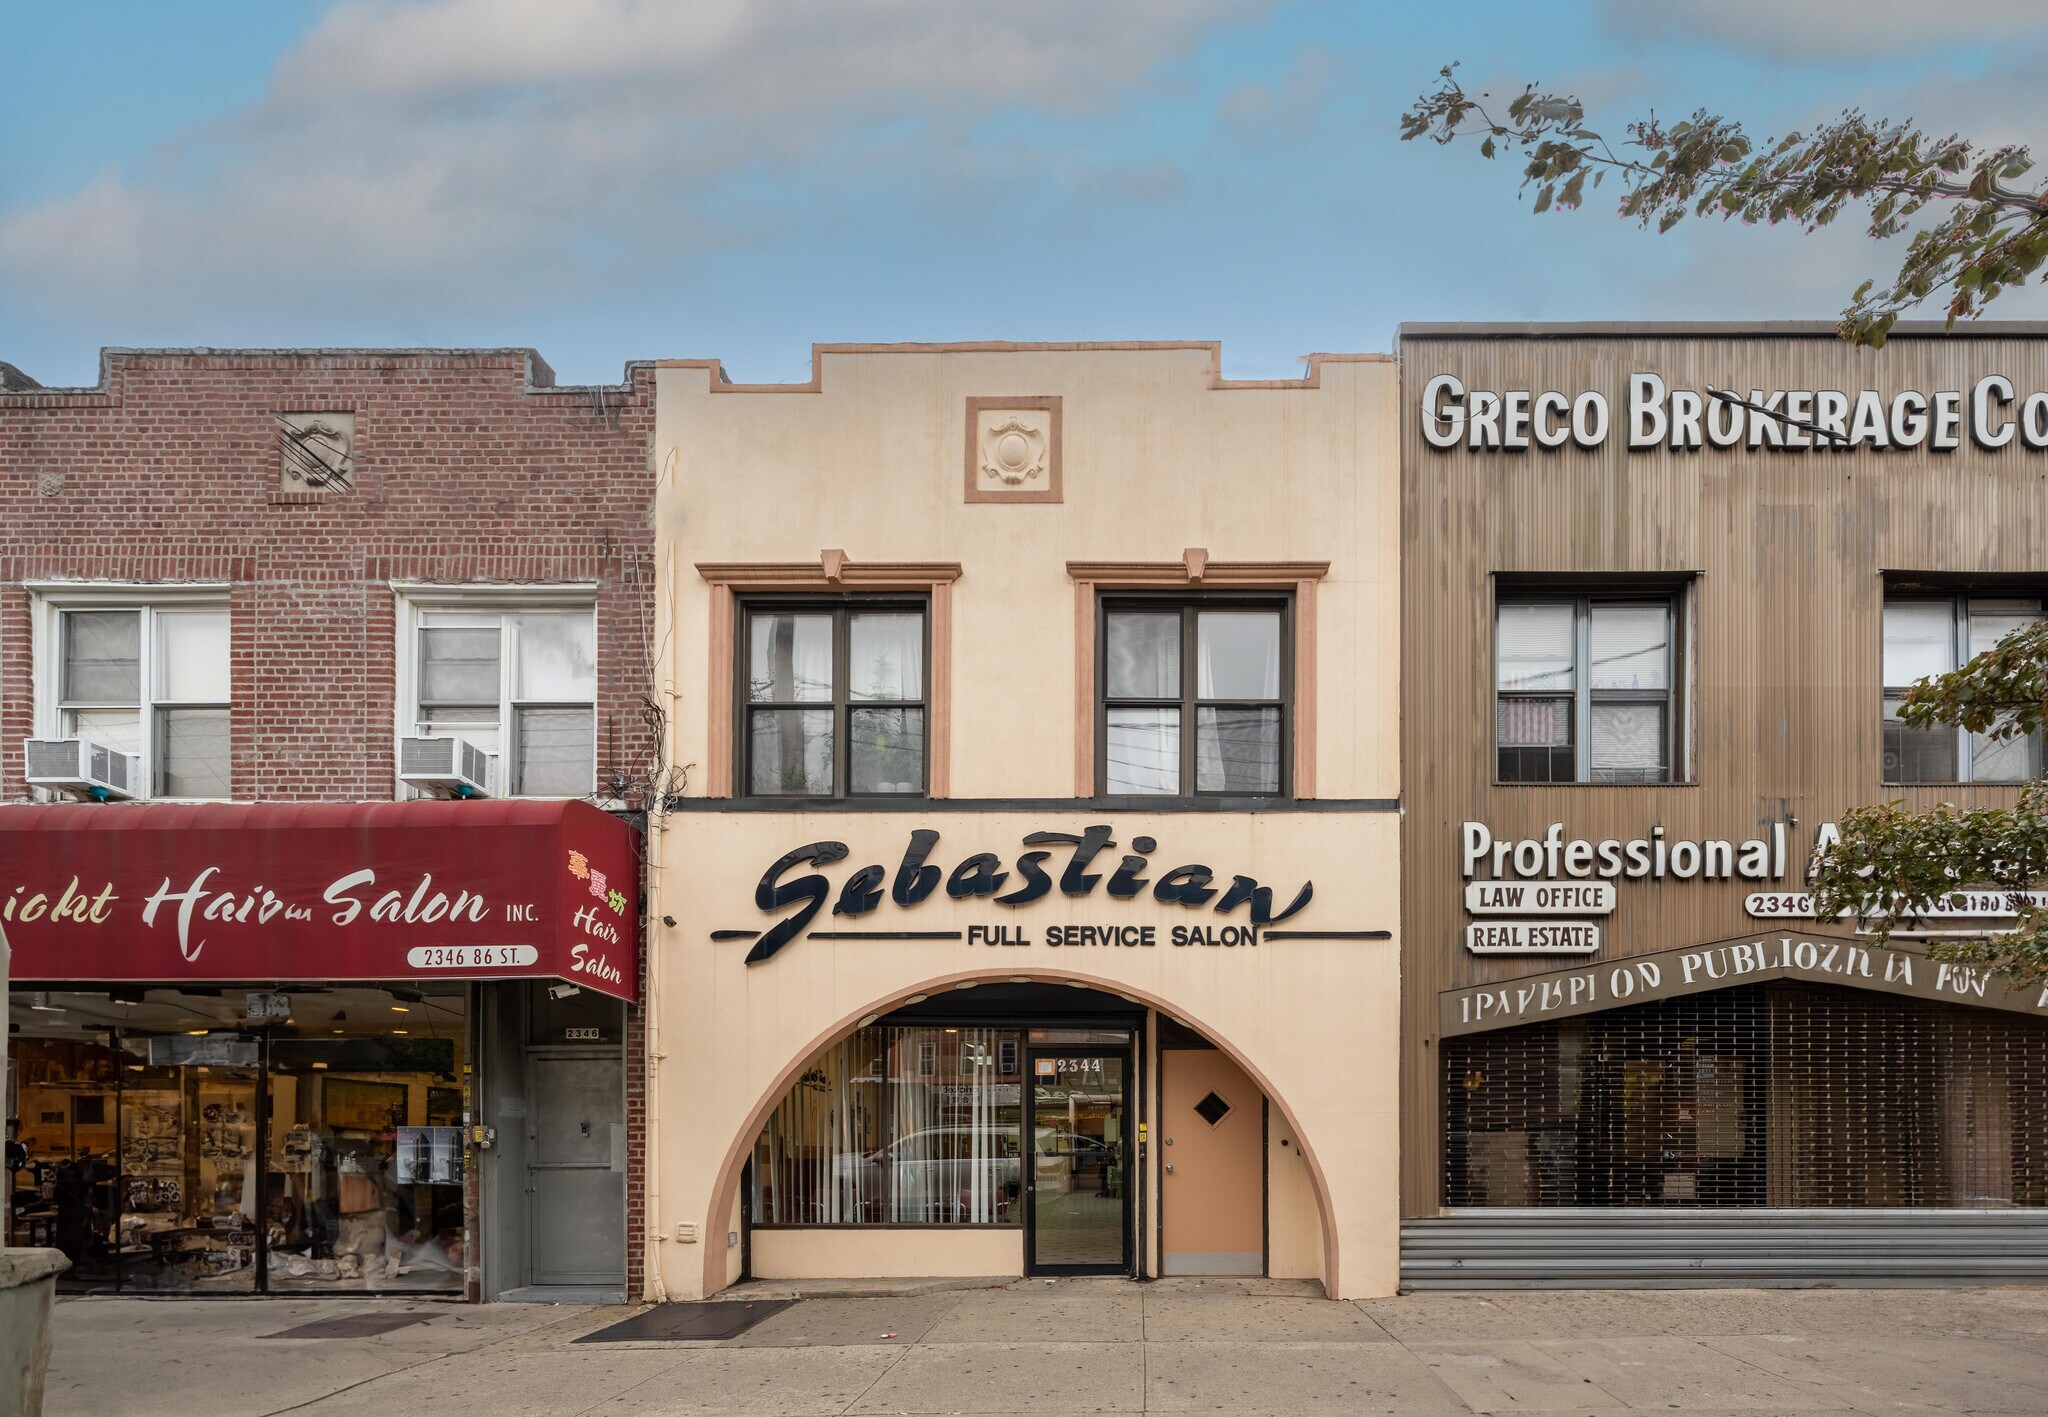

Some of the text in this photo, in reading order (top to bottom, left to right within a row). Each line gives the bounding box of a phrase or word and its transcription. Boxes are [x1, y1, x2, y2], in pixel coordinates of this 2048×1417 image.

[1422, 373, 1609, 449] GRECO
[1461, 821, 1786, 879] Professional
[323, 868, 490, 926] Salon
[506, 904, 539, 922] INC.
[744, 825, 1314, 965] Sebastian
[1479, 887, 1603, 908] LAW OFFICE
[573, 905, 620, 944] Hair
[967, 925, 1258, 947] FULL SERVICE SALON
[1473, 927, 1594, 947] REAL ESTATE
[424, 947, 521, 966] 2346 86 ST.
[570, 943, 622, 985] Salon
[567, 1029, 598, 1038] 2346
[1057, 1059, 1101, 1072] 2344
